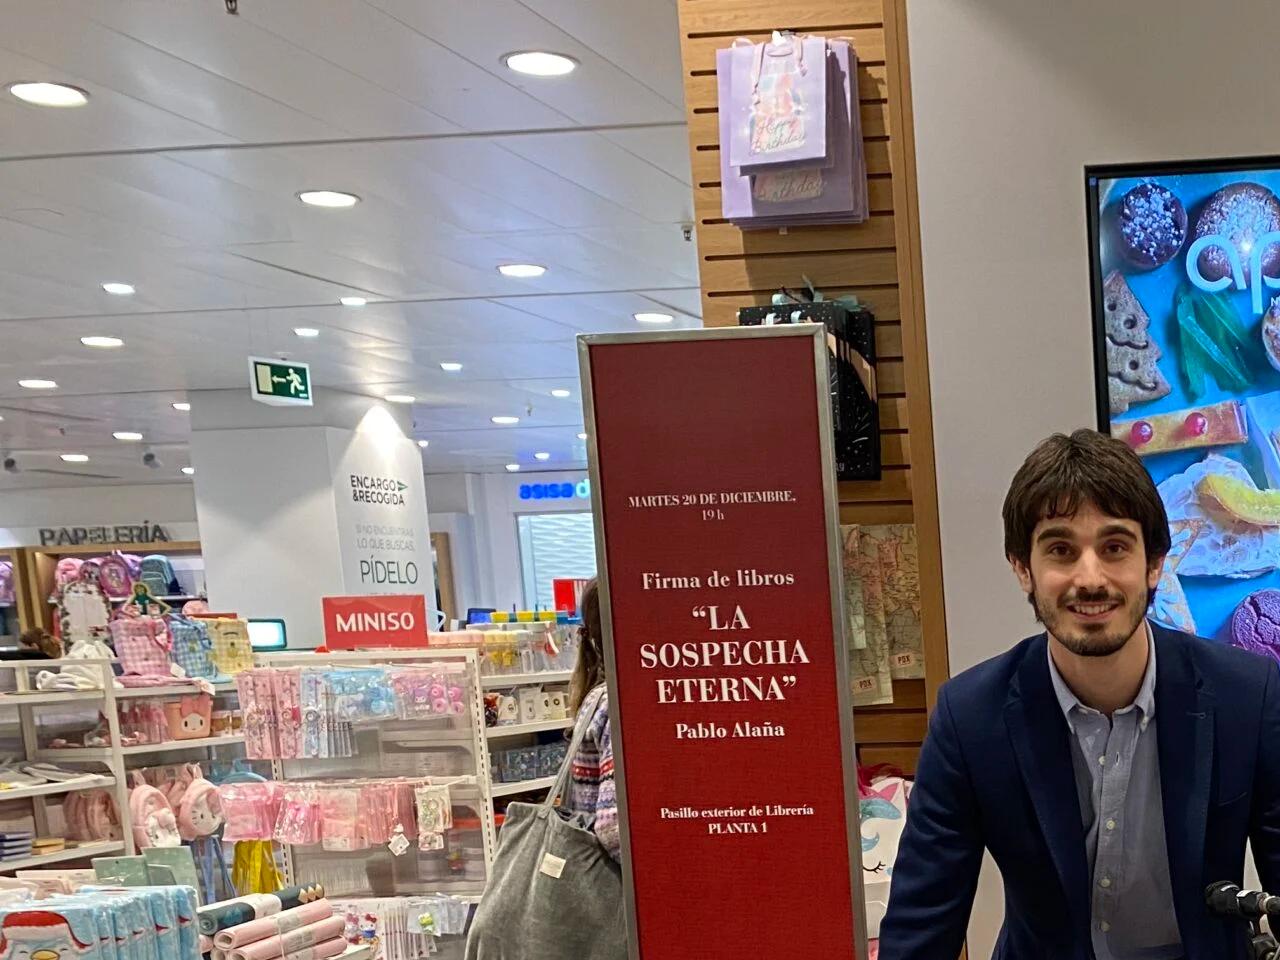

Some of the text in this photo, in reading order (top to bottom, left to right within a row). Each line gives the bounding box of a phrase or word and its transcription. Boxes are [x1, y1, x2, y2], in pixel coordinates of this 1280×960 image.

[350, 475, 396, 491] ENCARGO
[353, 489, 405, 506] &RECOGIDA
[629, 490, 797, 508] MARTES 20 DE DICIEMBRE.
[702, 509, 725, 520] 19 h
[39, 520, 168, 546] PAPELERÍA
[370, 539, 384, 550] QUE
[360, 555, 418, 584] PÍDELO
[642, 569, 795, 589] Firma de libros
[335, 612, 415, 632] MINISO
[640, 639, 810, 669] SOSPECHA
[656, 675, 797, 704] ETERNA”
[676, 721, 785, 739] Pablo Alaña
[660, 803, 814, 819] Pasillo exterior de Librería
[708, 822, 768, 834] PLANTA 1
